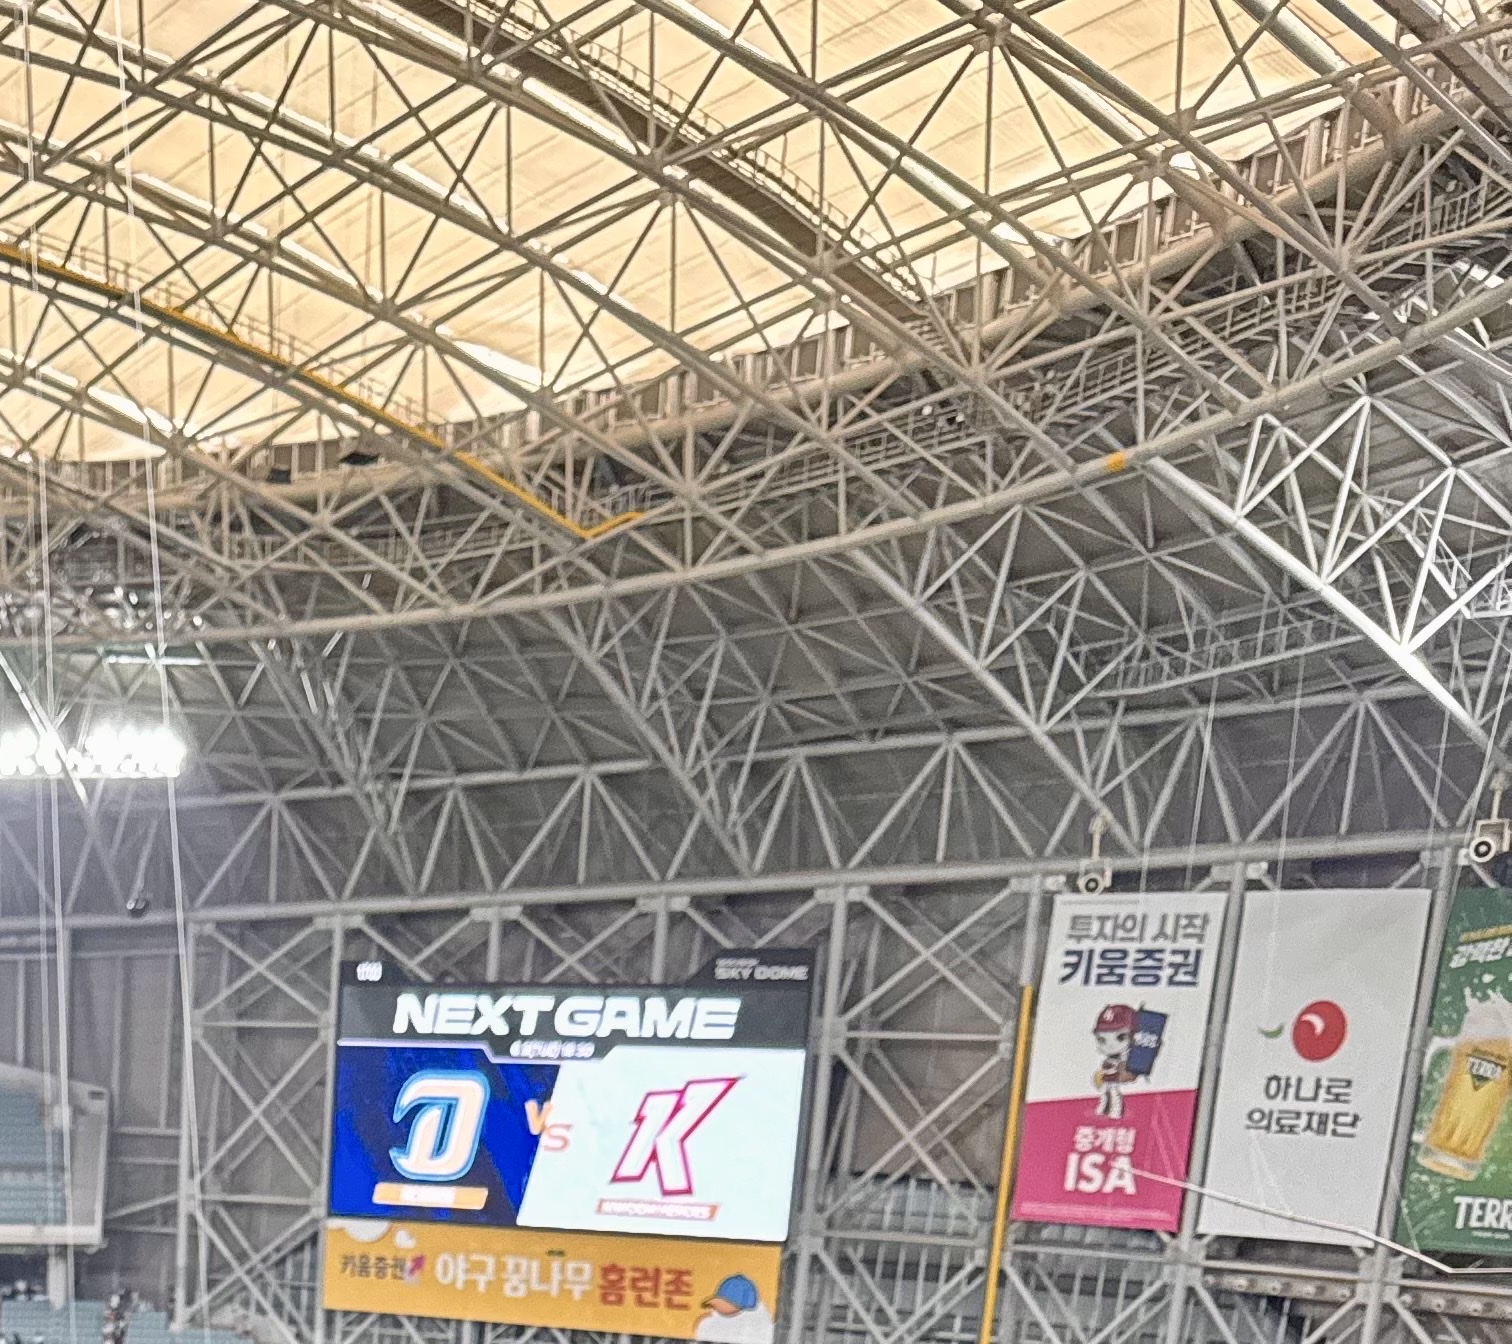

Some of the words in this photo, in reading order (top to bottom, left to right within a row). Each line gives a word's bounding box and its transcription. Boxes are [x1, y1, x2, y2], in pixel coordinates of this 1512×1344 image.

[1067, 912, 1146, 944] 투자의
[1150, 912, 1209, 944] 시작
[754, 965, 809, 981] DOME
[1059, 948, 1202, 987] 키움증권
[392, 993, 555, 1036] NEXT
[554, 995, 742, 1040] GAME
[1264, 1074, 1353, 1104] 하나로
[1245, 1107, 1362, 1138] 의료재단
[1064, 1152, 1137, 1195] ISA
[434, 1252, 495, 1295] 야구
[598, 1262, 695, 1310] 홈런존
